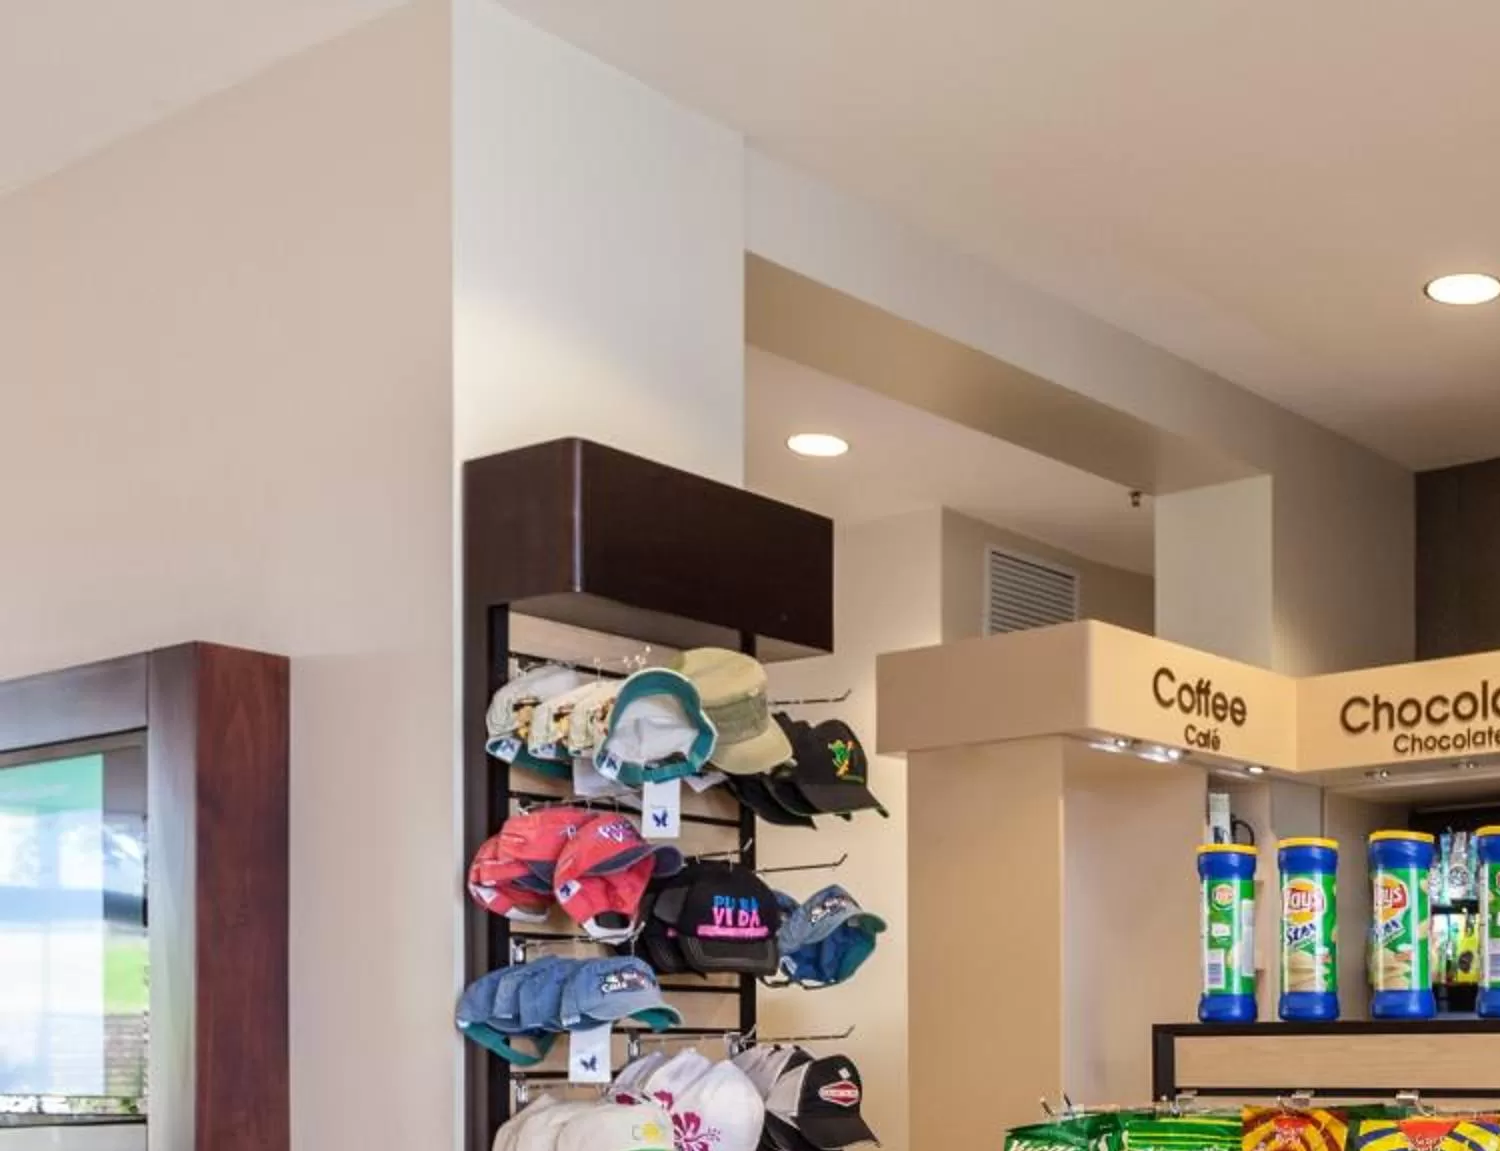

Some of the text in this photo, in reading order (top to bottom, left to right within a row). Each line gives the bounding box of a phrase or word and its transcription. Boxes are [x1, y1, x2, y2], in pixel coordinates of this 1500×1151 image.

[1152, 667, 1247, 727] Coffee
[1184, 723, 1221, 751] Café
[712, 909, 760, 926] VIDA
